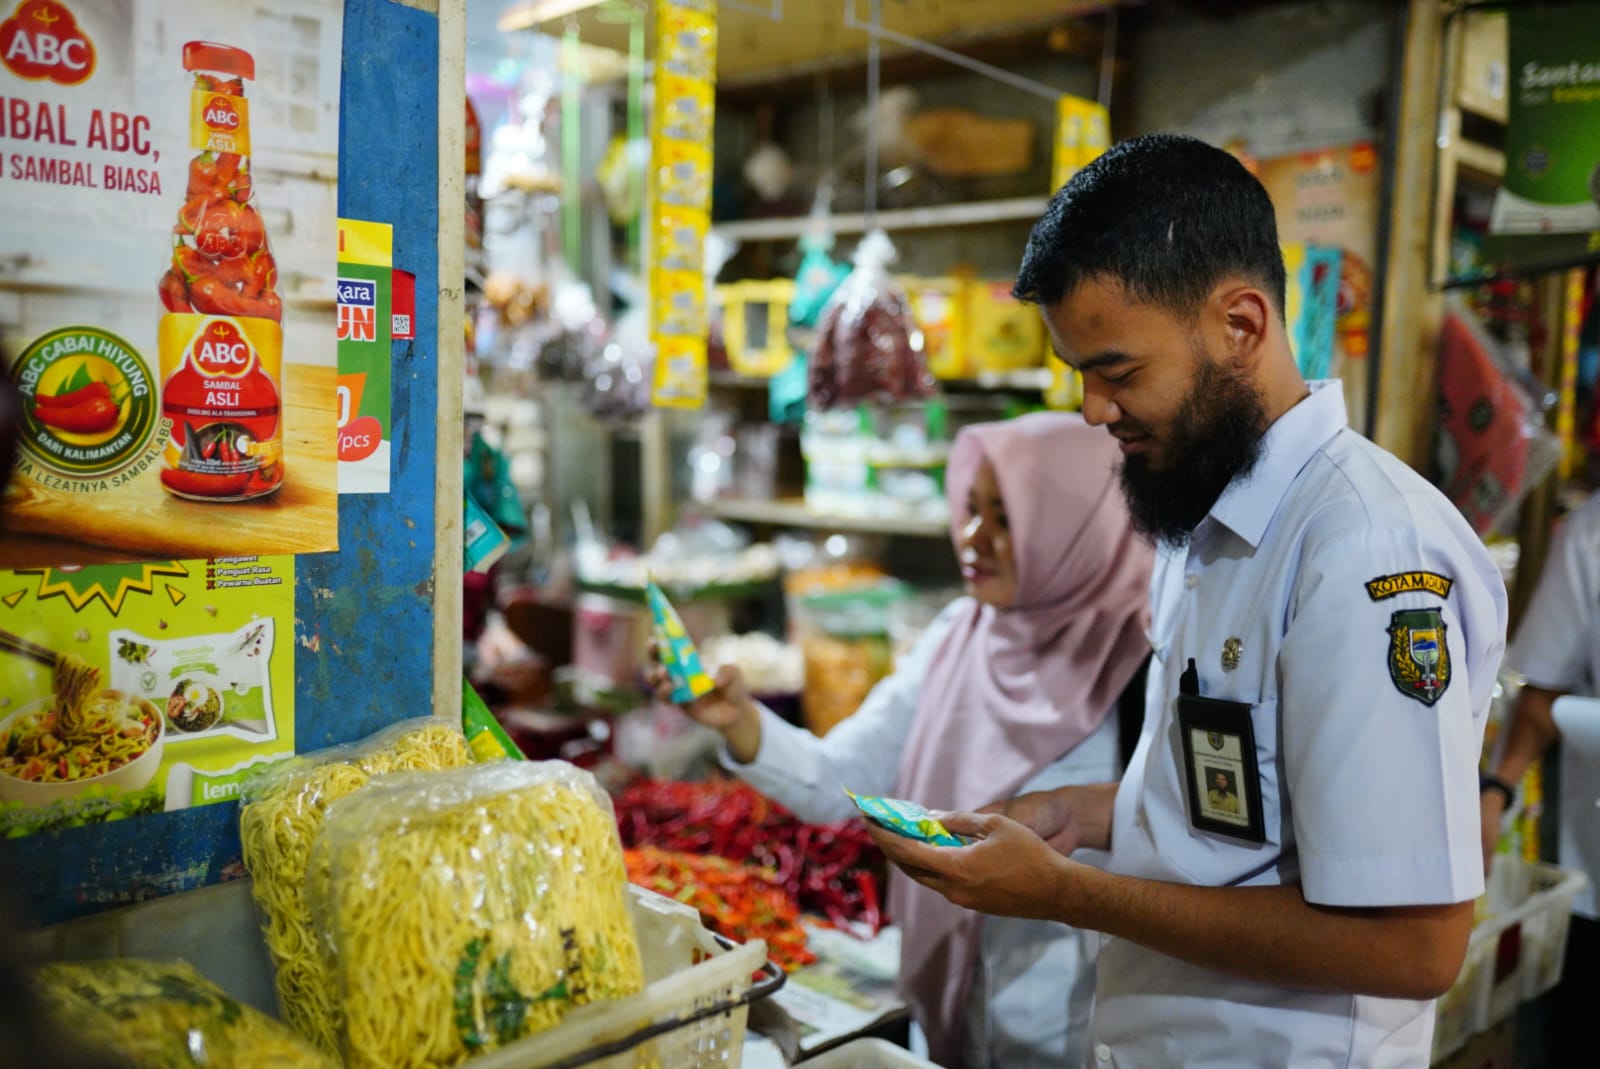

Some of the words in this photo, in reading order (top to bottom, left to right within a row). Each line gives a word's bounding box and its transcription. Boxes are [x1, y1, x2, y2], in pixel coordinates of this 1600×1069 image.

[6, 29, 87, 70] ABC
[206, 109, 238, 126] ABC
[87, 109, 160, 163] ABC,
[208, 138, 236, 152] ASLI
[11, 154, 98, 188] SAMBAL
[104, 165, 162, 195] BIASA
[199, 341, 246, 364] ABC
[18, 358, 46, 396] ABC
[41, 336, 95, 362] CABAI
[97, 339, 148, 397] HIYUNG
[203, 380, 241, 390] SAMBAL
[206, 391, 239, 406] ASLI
[36, 471, 108, 492] LEZATNYA
[112, 450, 160, 487] SAMBAL
[156, 416, 173, 447] ABG
[37, 432, 63, 454] DARI
[64, 432, 132, 459] KALIMANTAN
[217, 568, 250, 577] Penguat
[252, 566, 271, 574] Rasa
[254, 577, 281, 585] Buatan
[1371, 575, 1409, 596] KOTA
